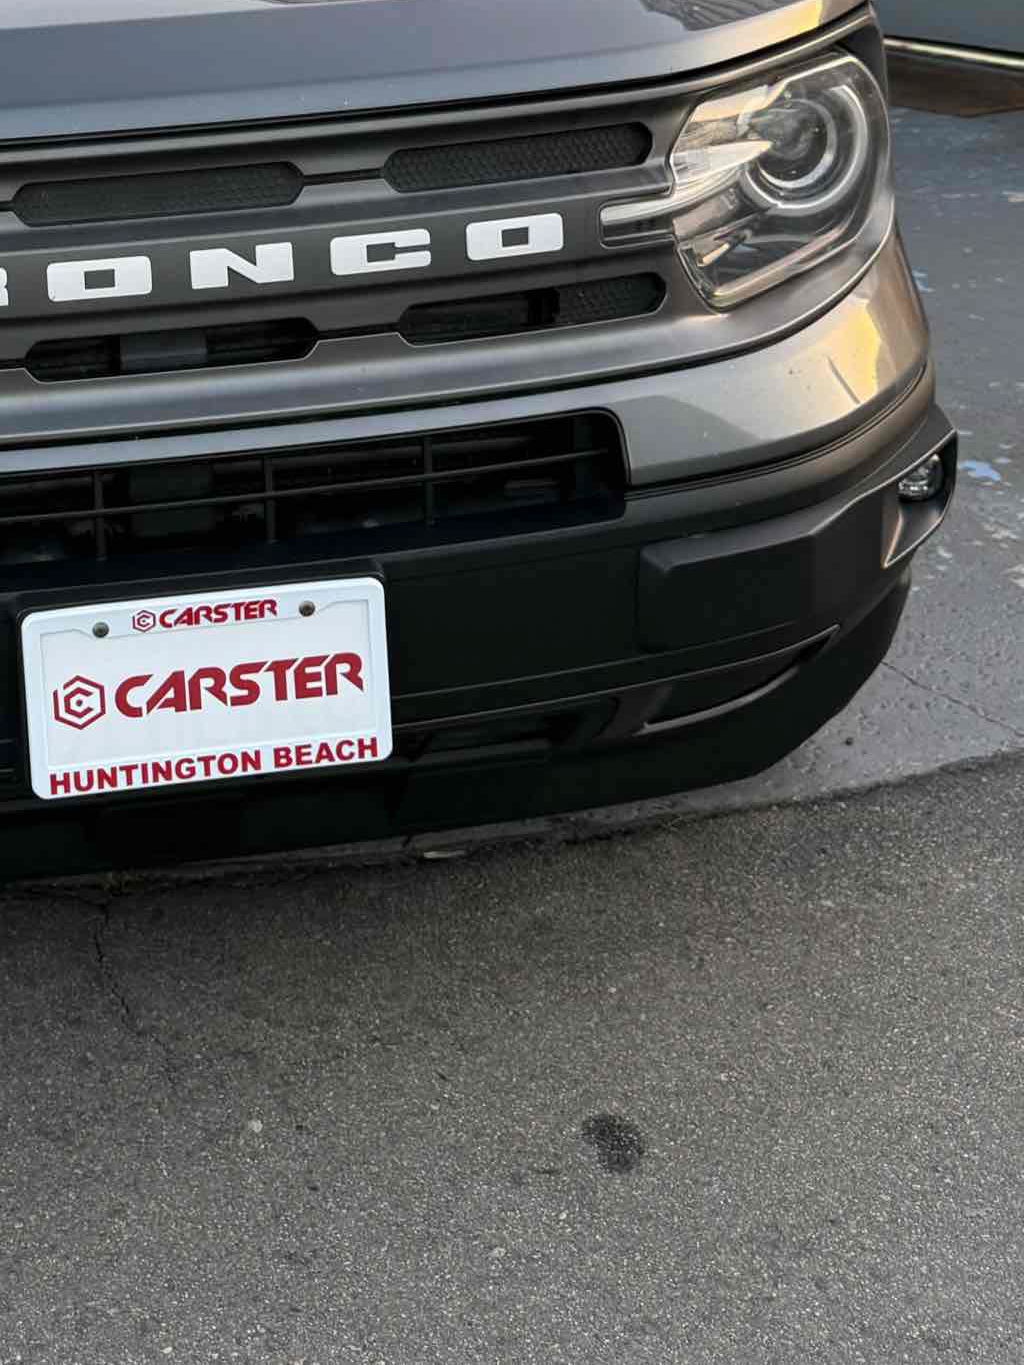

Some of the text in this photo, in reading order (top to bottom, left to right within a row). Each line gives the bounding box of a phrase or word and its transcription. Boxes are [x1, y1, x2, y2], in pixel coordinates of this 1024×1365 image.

[158, 599, 278, 629] CARSTER
[114, 652, 364, 718] CARSTER
[49, 737, 379, 795] HUNTINGTON BEACH
